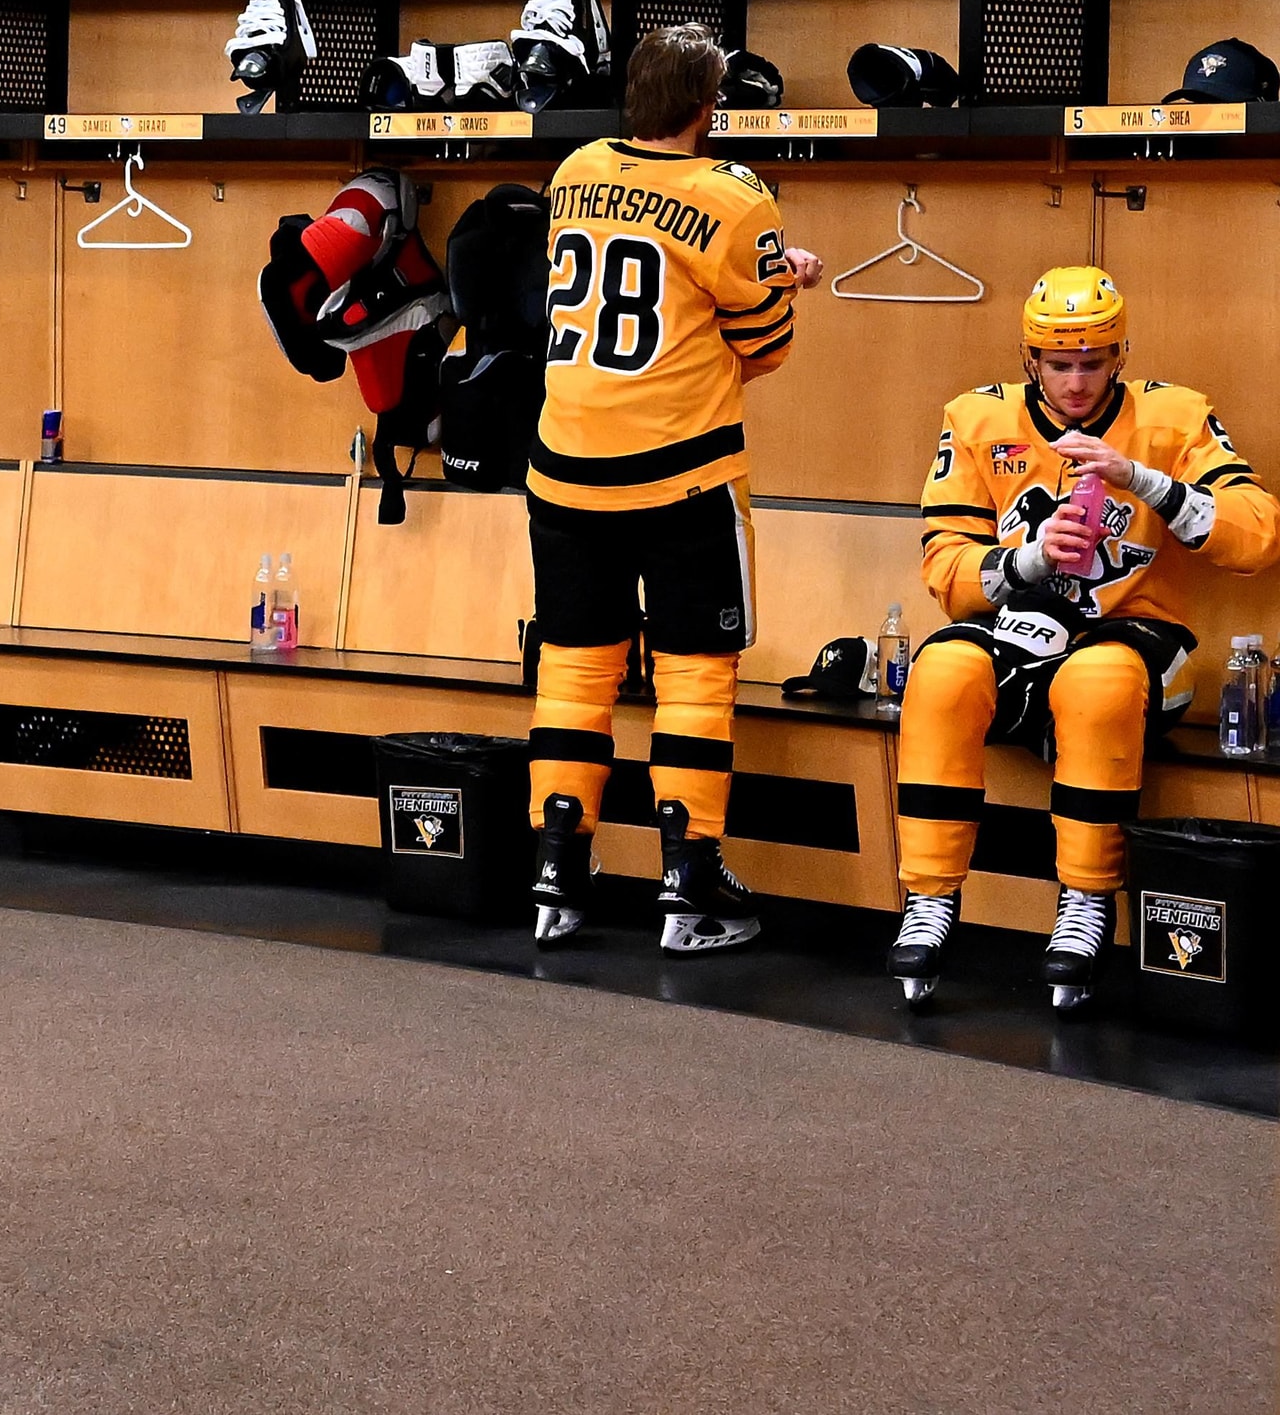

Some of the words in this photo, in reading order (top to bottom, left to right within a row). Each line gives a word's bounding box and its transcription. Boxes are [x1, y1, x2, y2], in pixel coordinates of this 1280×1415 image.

[47, 117, 66, 134] 49
[82, 119, 113, 133] SAMUEL
[138, 119, 167, 133] GIRARD
[373, 115, 392, 134] 27
[416, 118, 437, 132] RYAN
[459, 117, 489, 132] GRAVES
[711, 112, 729, 132] 28
[738, 115, 771, 129] PARKER
[798, 115, 848, 129] WOTHERSPOON
[1073, 109, 1083, 129] 5
[1121, 111, 1144, 127] RYAN
[1169, 110, 1191, 126] SHEA
[546, 228, 667, 377] 28
[1065, 298, 1076, 313] 5
[932, 430, 954, 483] 5
[393, 797, 458, 815] PENGUINS
[1145, 904, 1221, 931] PENGUINS
